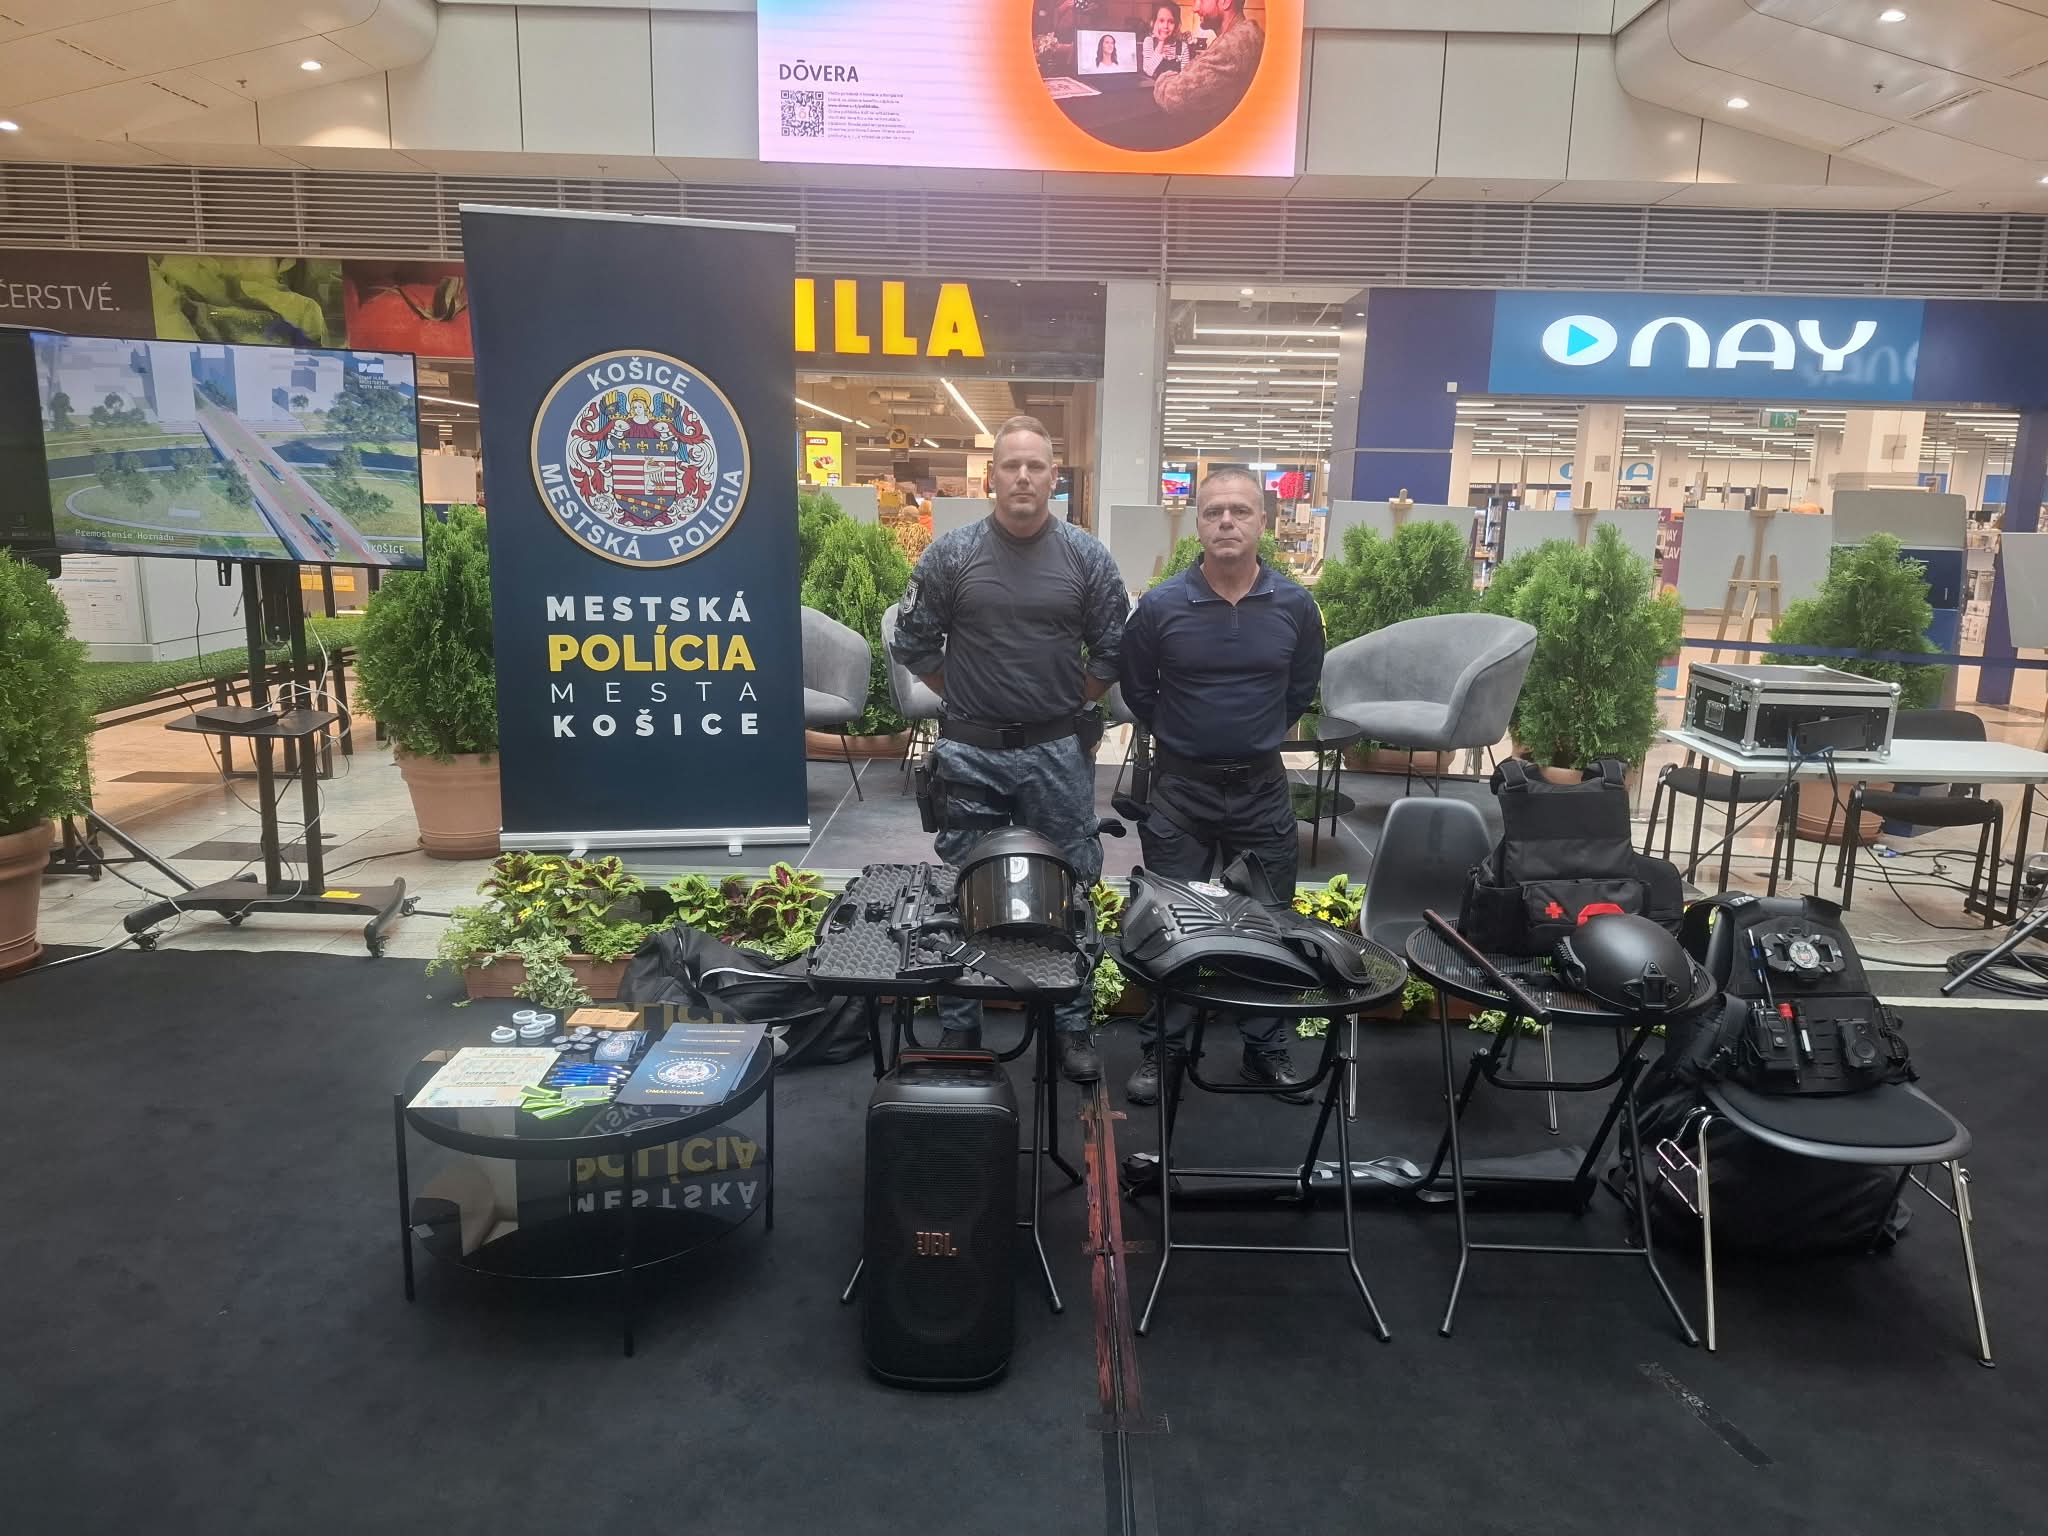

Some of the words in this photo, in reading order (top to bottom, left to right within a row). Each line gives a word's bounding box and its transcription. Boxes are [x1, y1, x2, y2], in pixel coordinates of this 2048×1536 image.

[795, 278, 985, 357] ILLA
[1629, 316, 1878, 371] NAY
[587, 357, 690, 395] KOŠICE
[541, 463, 641, 559] MESTSKÁ
[668, 470, 743, 555] POLÍCIA
[75, 528, 133, 539] Premostenie
[371, 543, 405, 554] KOŠICE
[546, 591, 751, 622] MESTSKÁ
[548, 624, 756, 672] POLÍCIA
[551, 681, 758, 704] MESTA
[553, 708, 759, 738] KOŠICE
[915, 1231, 960, 1256] JBL
